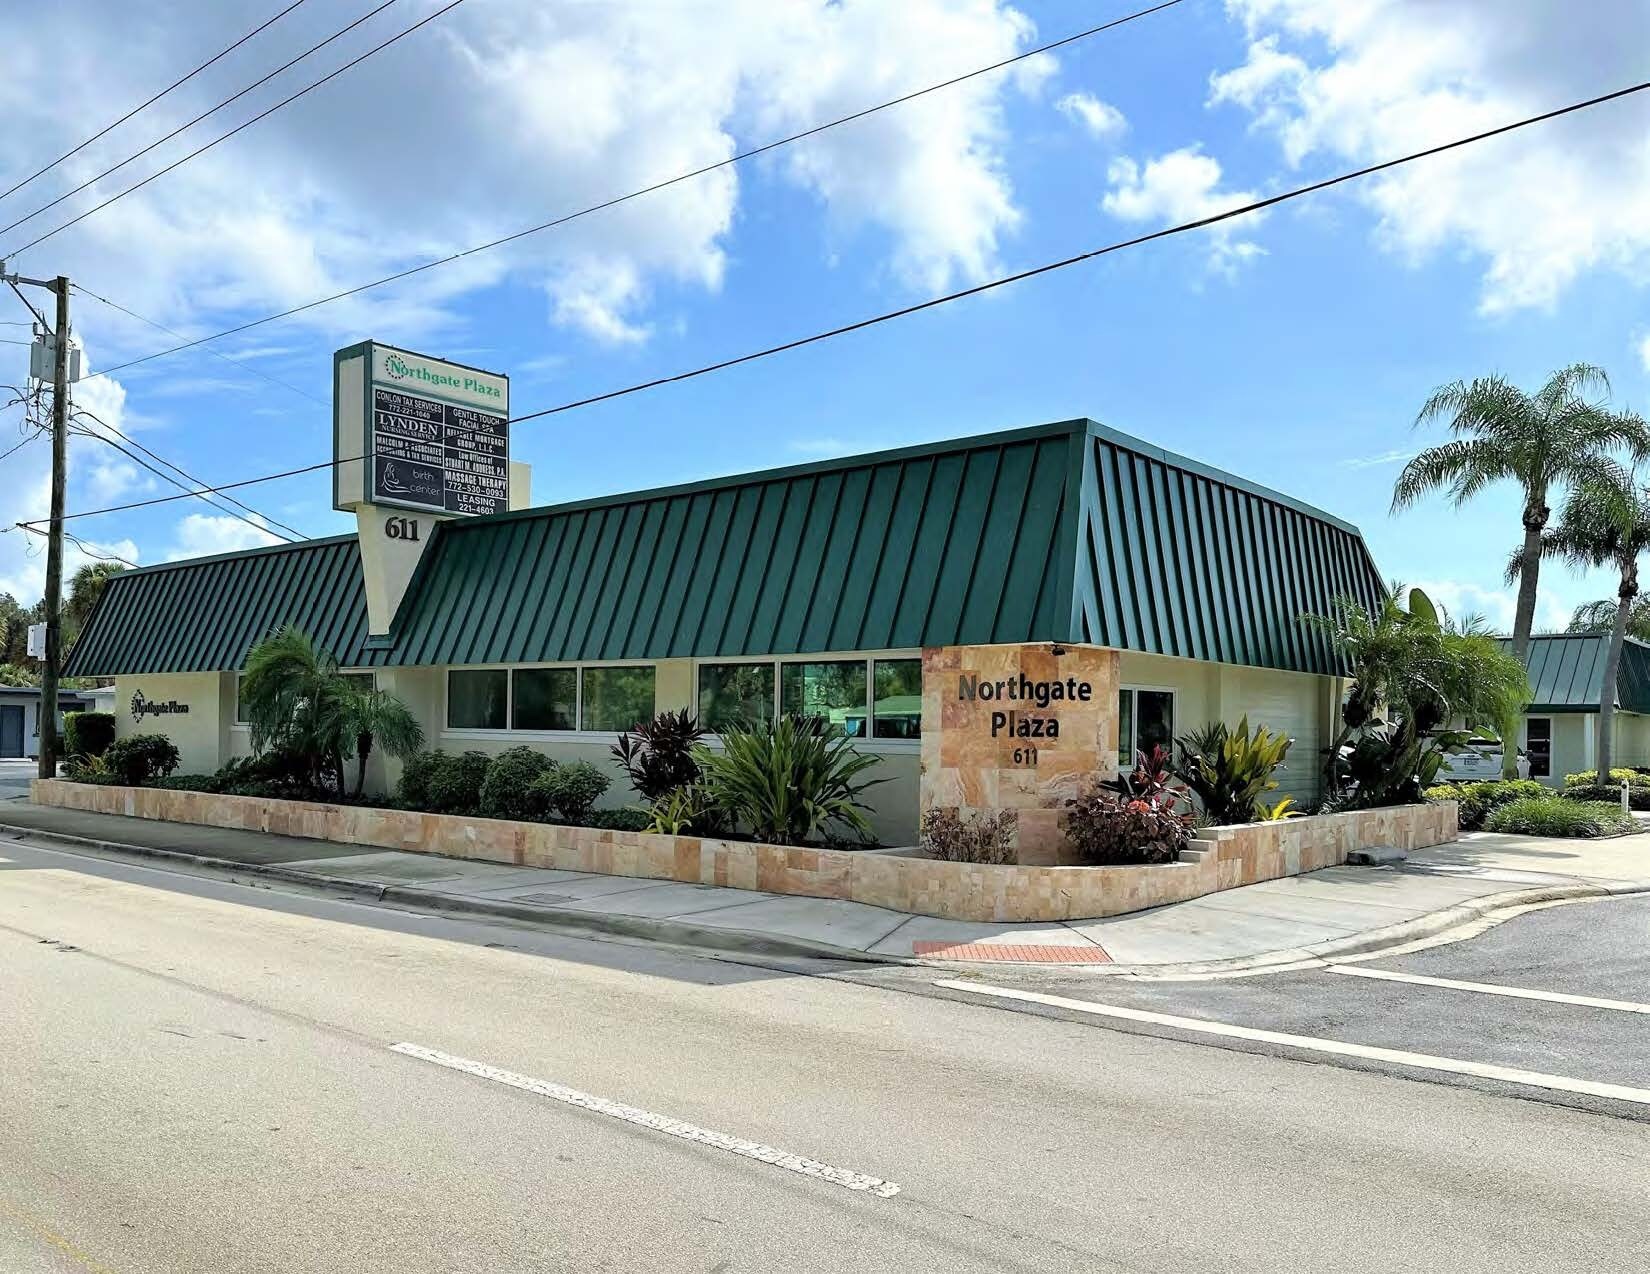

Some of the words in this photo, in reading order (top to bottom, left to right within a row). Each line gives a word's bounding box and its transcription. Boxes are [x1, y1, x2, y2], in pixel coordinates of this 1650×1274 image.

[391, 359, 460, 387] Northgate
[464, 377, 501, 398] Plaza
[376, 391, 402, 403] CONLON
[402, 397, 414, 407] TAX
[414, 400, 442, 414] SERVICES
[380, 414, 440, 436] LYNDEN
[453, 408, 478, 422] GENTLE
[478, 414, 500, 426] TOUCH
[458, 418, 480, 431] FACIAL
[376, 436, 404, 449] MALCOLM
[474, 434, 505, 448] MORTGAGE
[458, 451, 469, 461] Law
[445, 470, 477, 485] MASSAGE
[478, 476, 506, 490] THERAPY
[409, 484, 441, 496] center
[448, 481, 504, 498] 772-530-0093
[457, 493, 496, 507] LEASING
[385, 516, 420, 541] 611
[959, 672, 1092, 708] Northgate
[991, 710, 1060, 738] Plaza
[1013, 747, 1038, 765] 611
